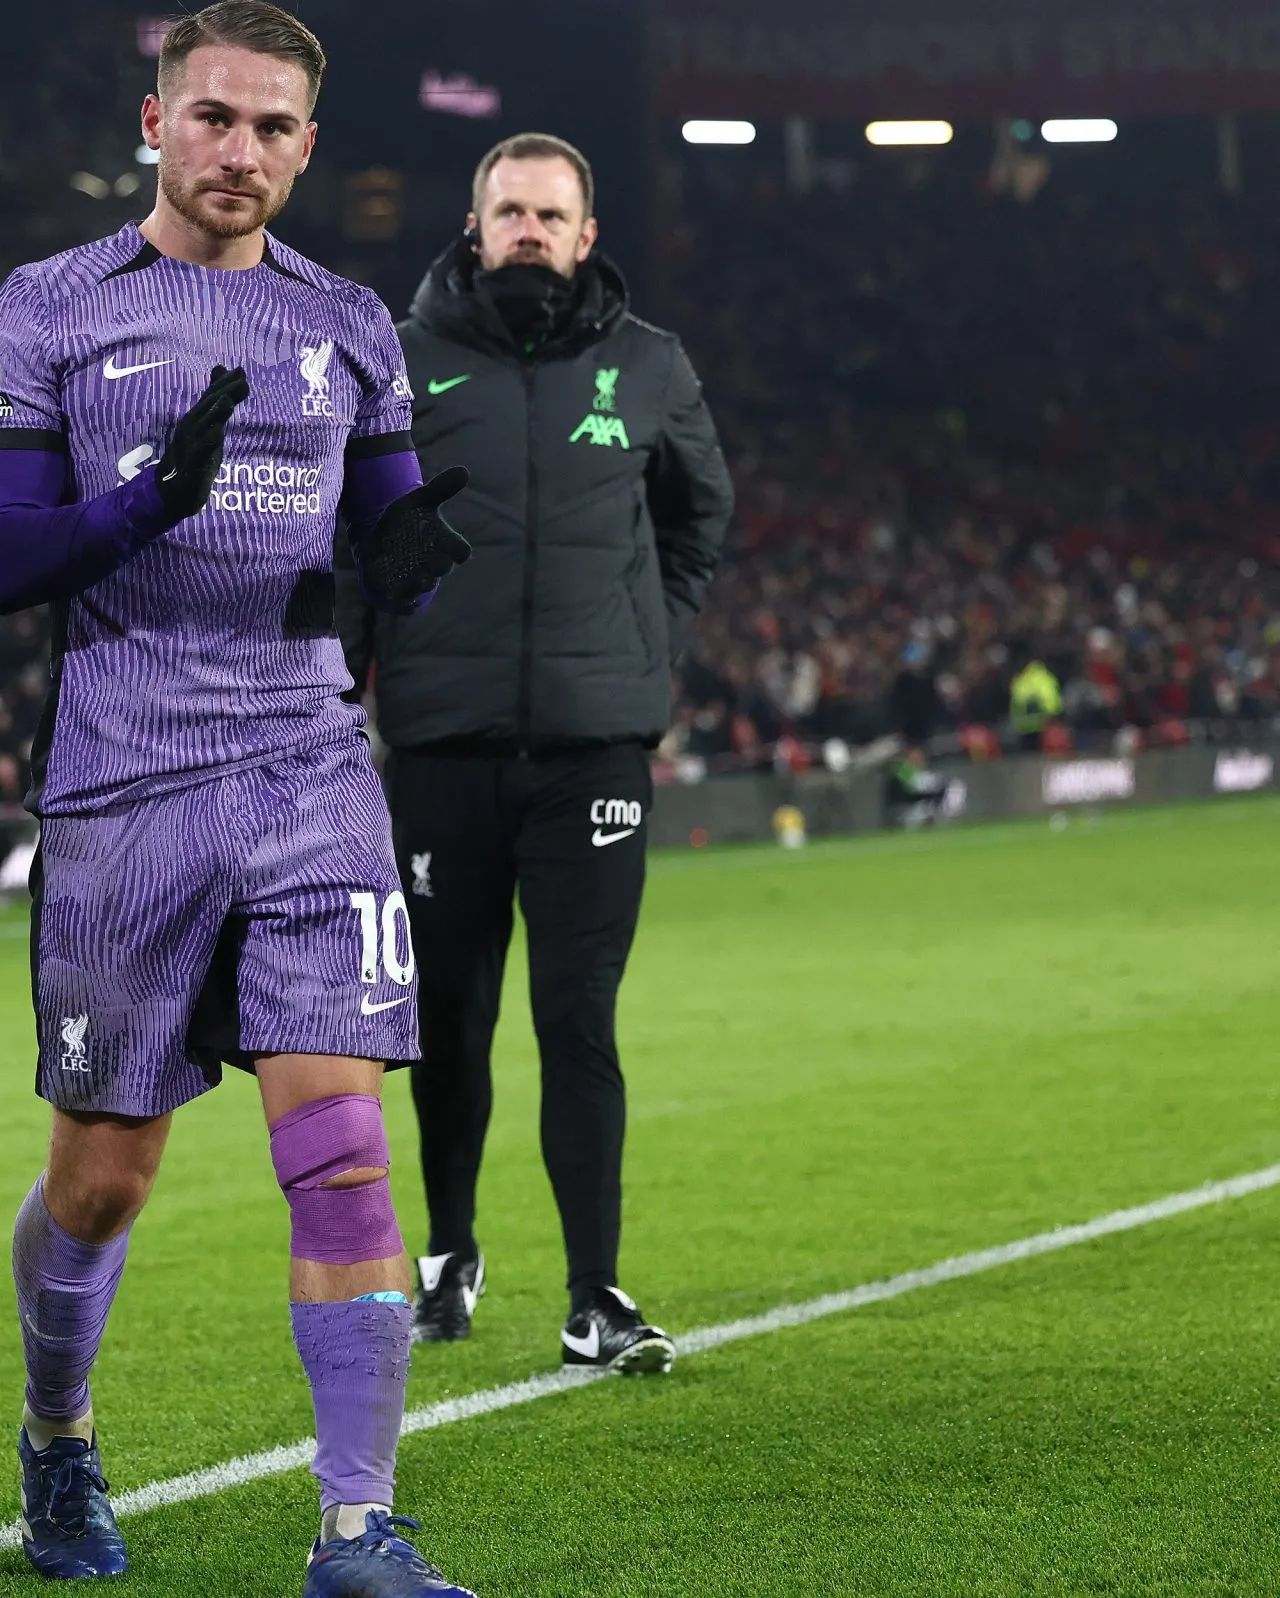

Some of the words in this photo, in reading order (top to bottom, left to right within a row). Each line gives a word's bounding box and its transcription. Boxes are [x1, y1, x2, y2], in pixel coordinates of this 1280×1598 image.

[568, 413, 630, 449] AXA
[213, 460, 323, 488] andard
[350, 890, 415, 985] 10
